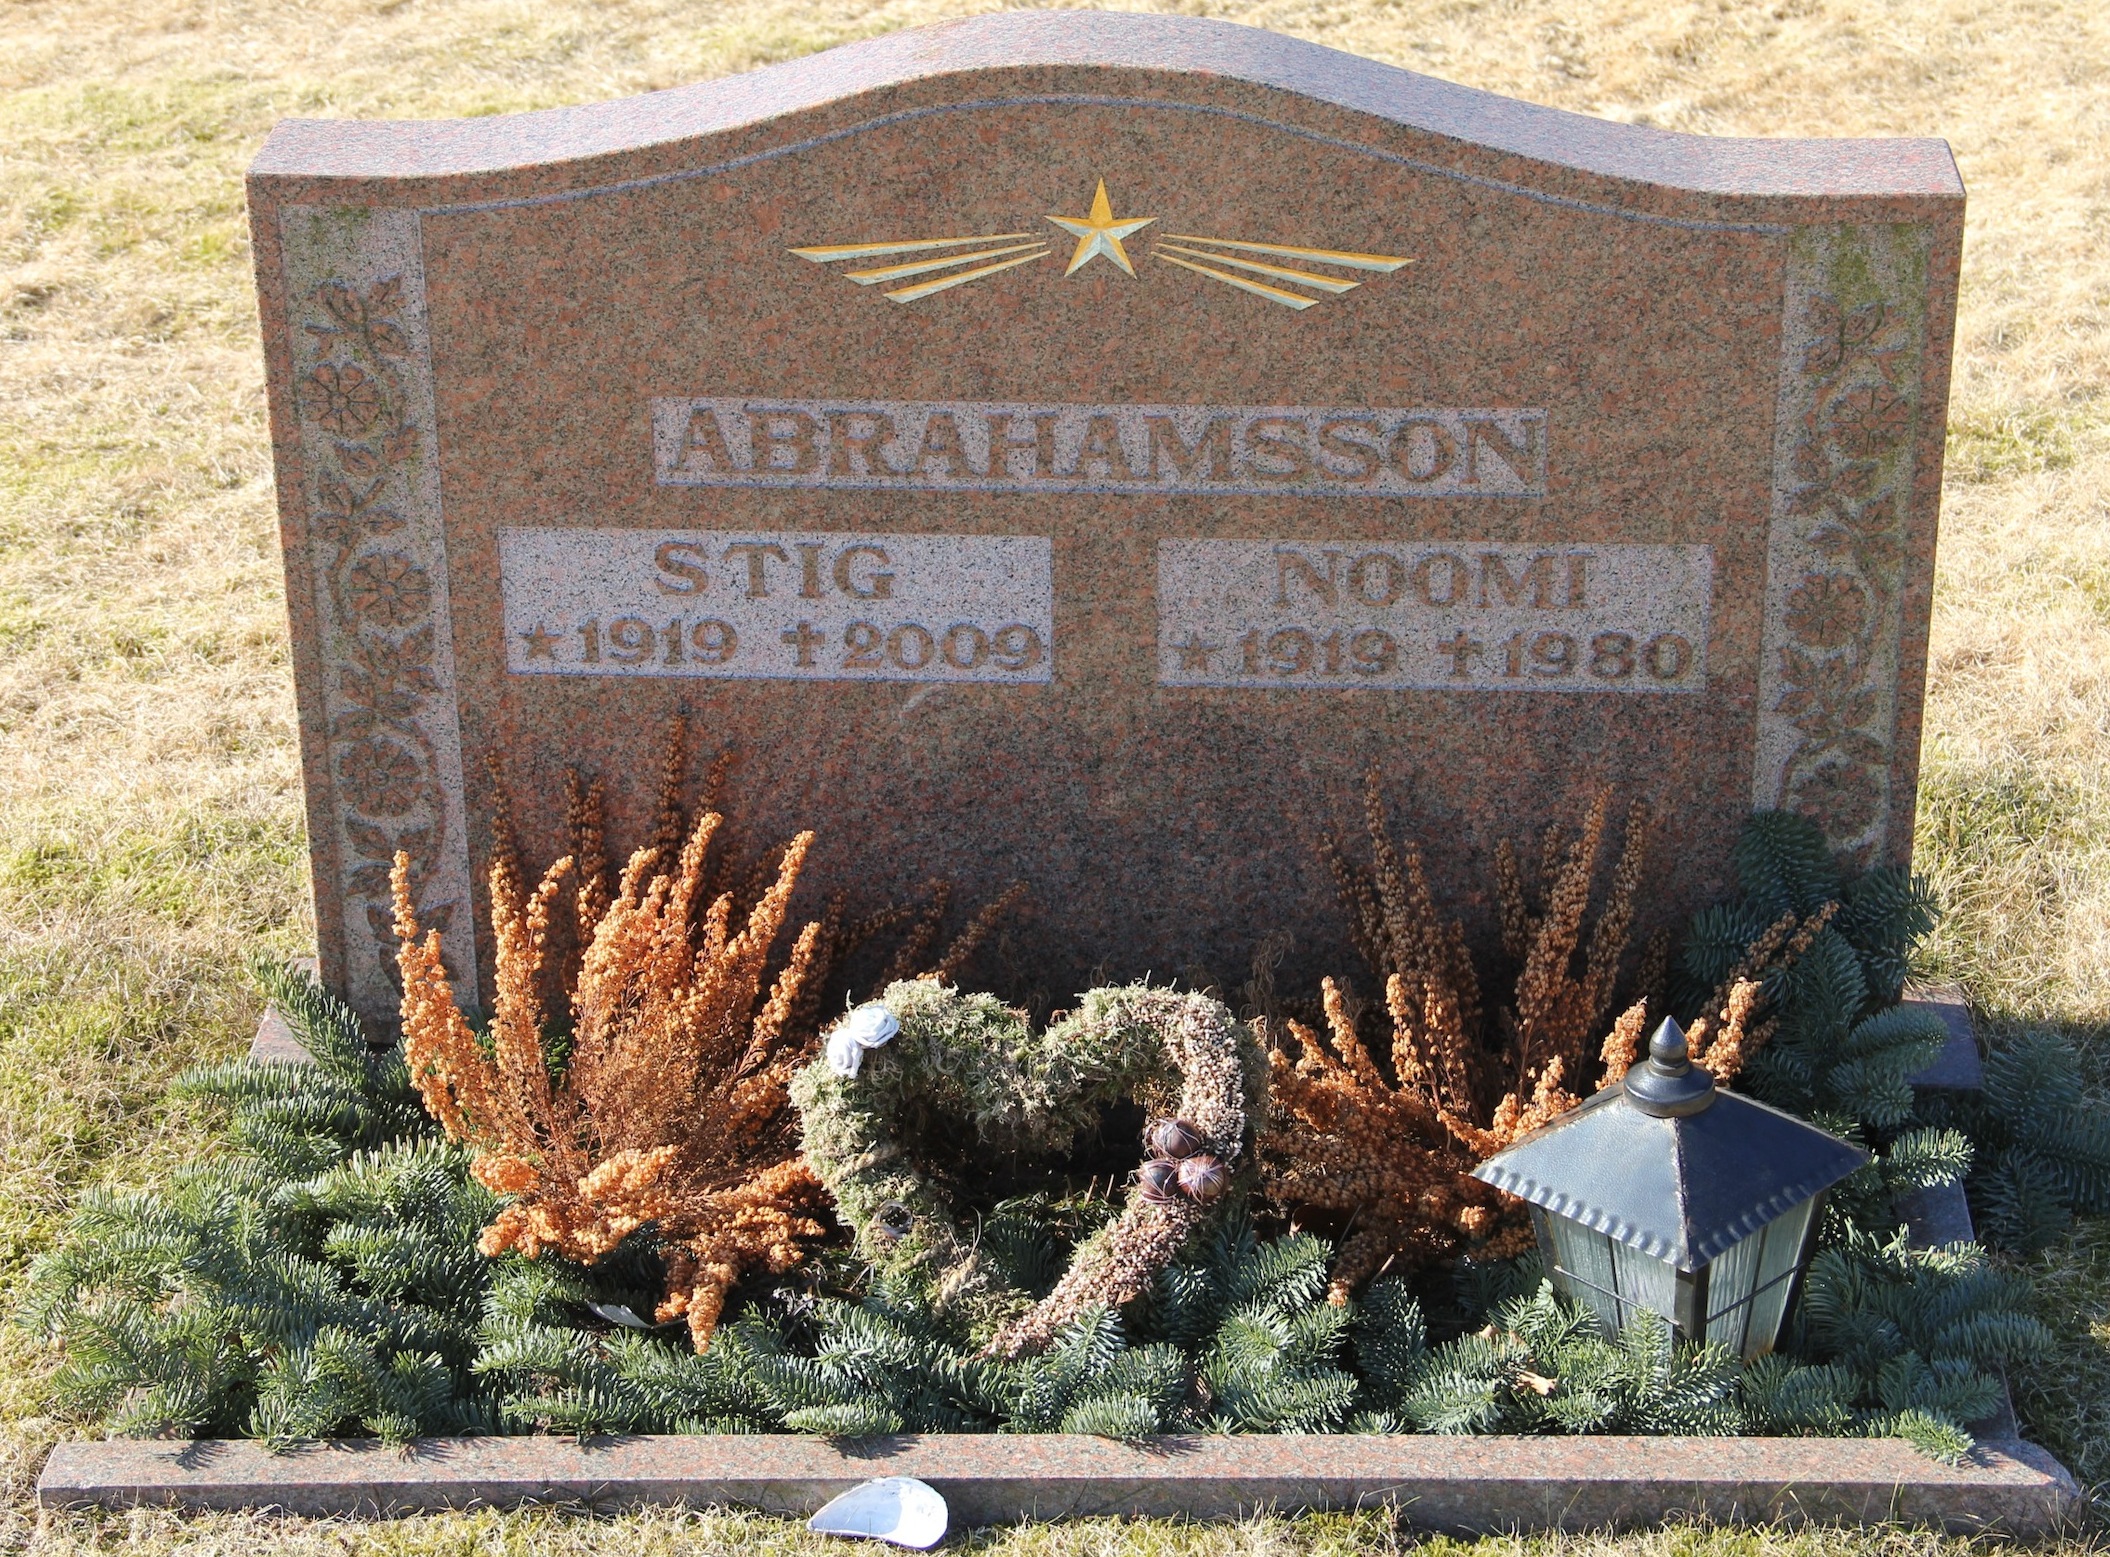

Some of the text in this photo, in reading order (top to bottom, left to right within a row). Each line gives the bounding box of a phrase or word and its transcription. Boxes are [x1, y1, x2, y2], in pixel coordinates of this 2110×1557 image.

[669, 405, 1543, 485] ABRAHAMSSON
[652, 540, 897, 600] STIG
[1271, 547, 1597, 609] NOOMI
[576, 612, 1043, 671] 1919 2009
[1234, 626, 1694, 681] 1919 1980
